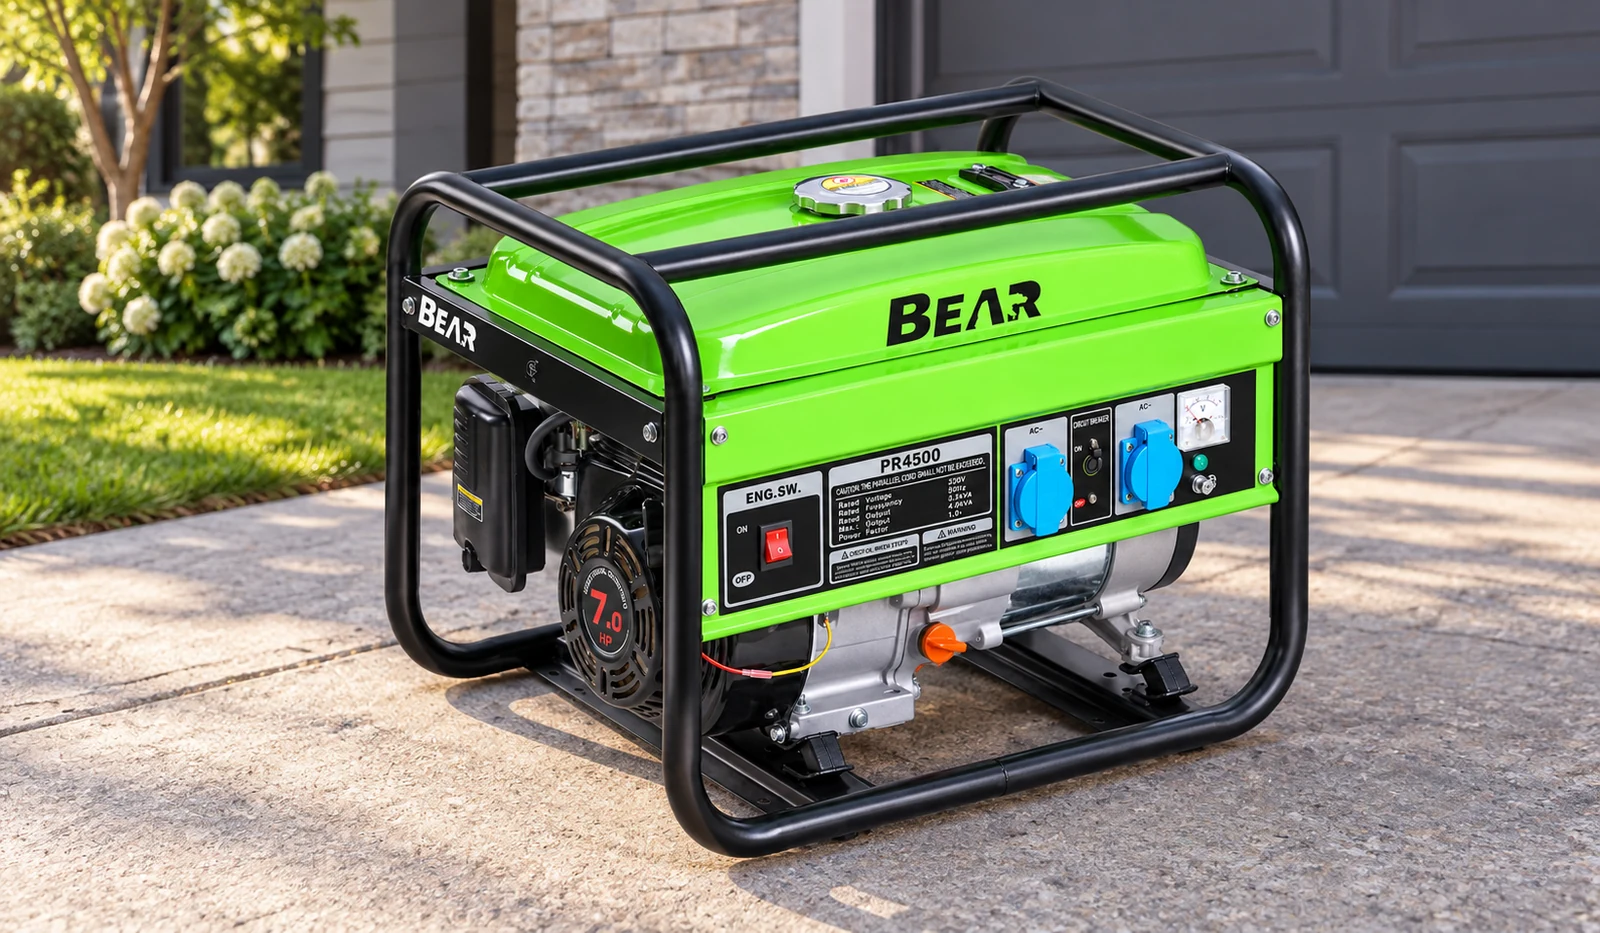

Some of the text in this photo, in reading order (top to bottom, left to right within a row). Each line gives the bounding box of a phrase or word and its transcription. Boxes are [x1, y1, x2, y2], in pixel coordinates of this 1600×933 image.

[886, 280, 1042, 347] BEAR
[418, 294, 477, 353] BEAR
[1074, 445, 1083, 453] ON
[880, 448, 941, 473] PR4500
[746, 482, 802, 504] ENG.SW.
[839, 499, 860, 509] Rated
[839, 508, 860, 517] Rated
[839, 516, 860, 525] Rated
[736, 525, 748, 535] ON
[590, 588, 623, 633] 7.0
[599, 632, 613, 647] HP
